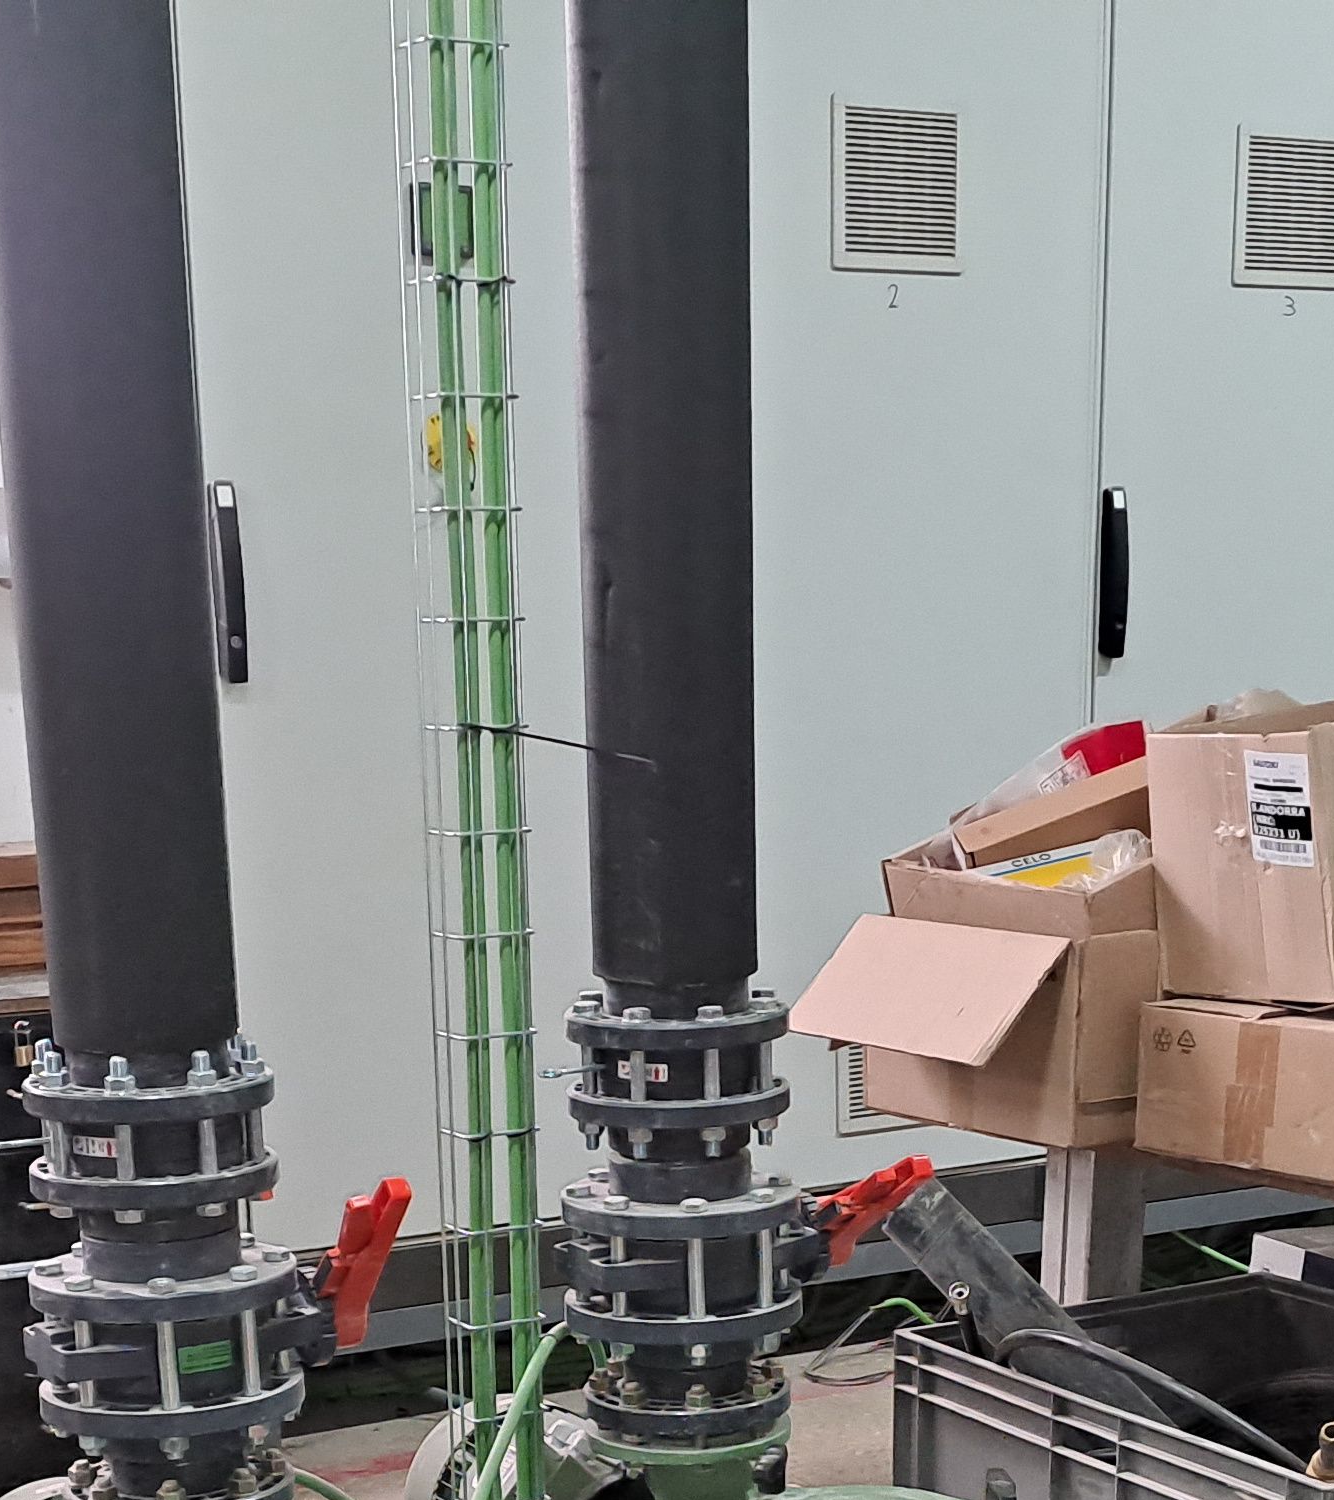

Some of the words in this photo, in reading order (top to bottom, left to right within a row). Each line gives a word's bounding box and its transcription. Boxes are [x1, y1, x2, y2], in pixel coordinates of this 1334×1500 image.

[888, 283, 899, 309] 2
[1283, 295, 1296, 316] 3
[1011, 853, 1052, 867] CELO
